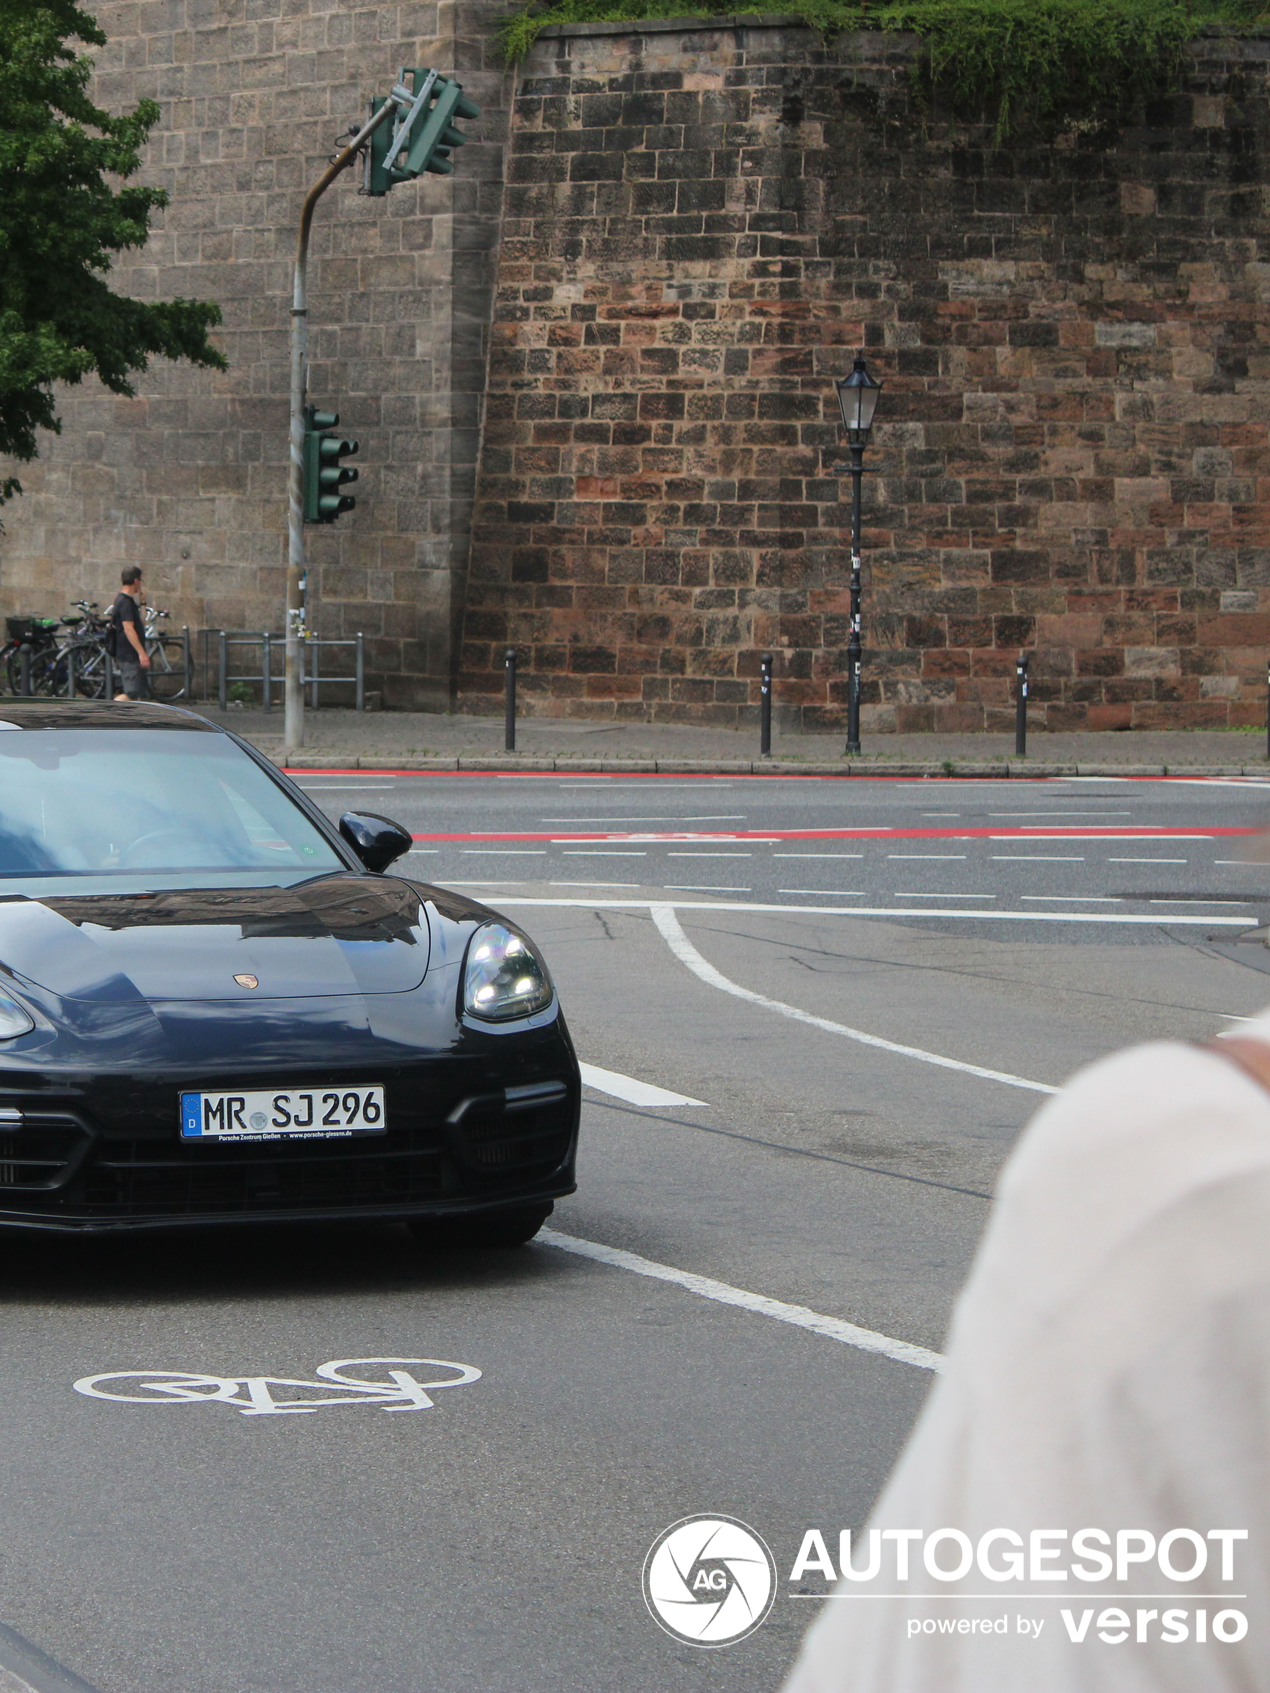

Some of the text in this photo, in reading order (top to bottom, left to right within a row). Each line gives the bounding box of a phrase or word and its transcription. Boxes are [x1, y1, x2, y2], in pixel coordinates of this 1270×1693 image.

[203, 1091, 381, 1131] MR SJ 296
[188, 1119, 196, 1128] D
[240, 1133, 262, 1141] Zentrum
